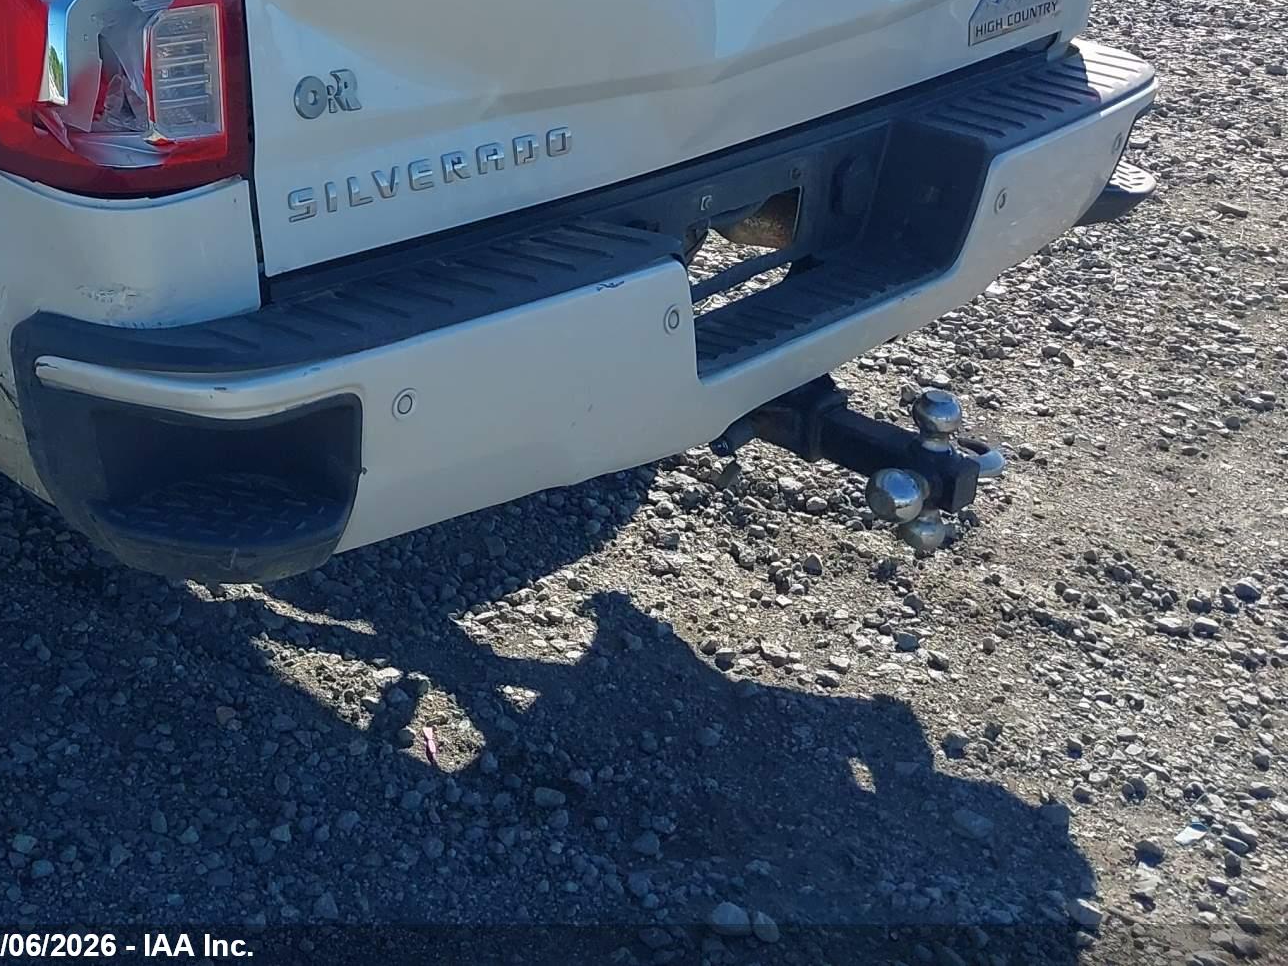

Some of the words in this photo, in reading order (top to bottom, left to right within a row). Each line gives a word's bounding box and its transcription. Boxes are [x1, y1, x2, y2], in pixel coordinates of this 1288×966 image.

[975, 17, 1003, 37] HIGH
[1007, 0, 1058, 26] COUNTRY
[287, 126, 572, 223] SILVERADO
